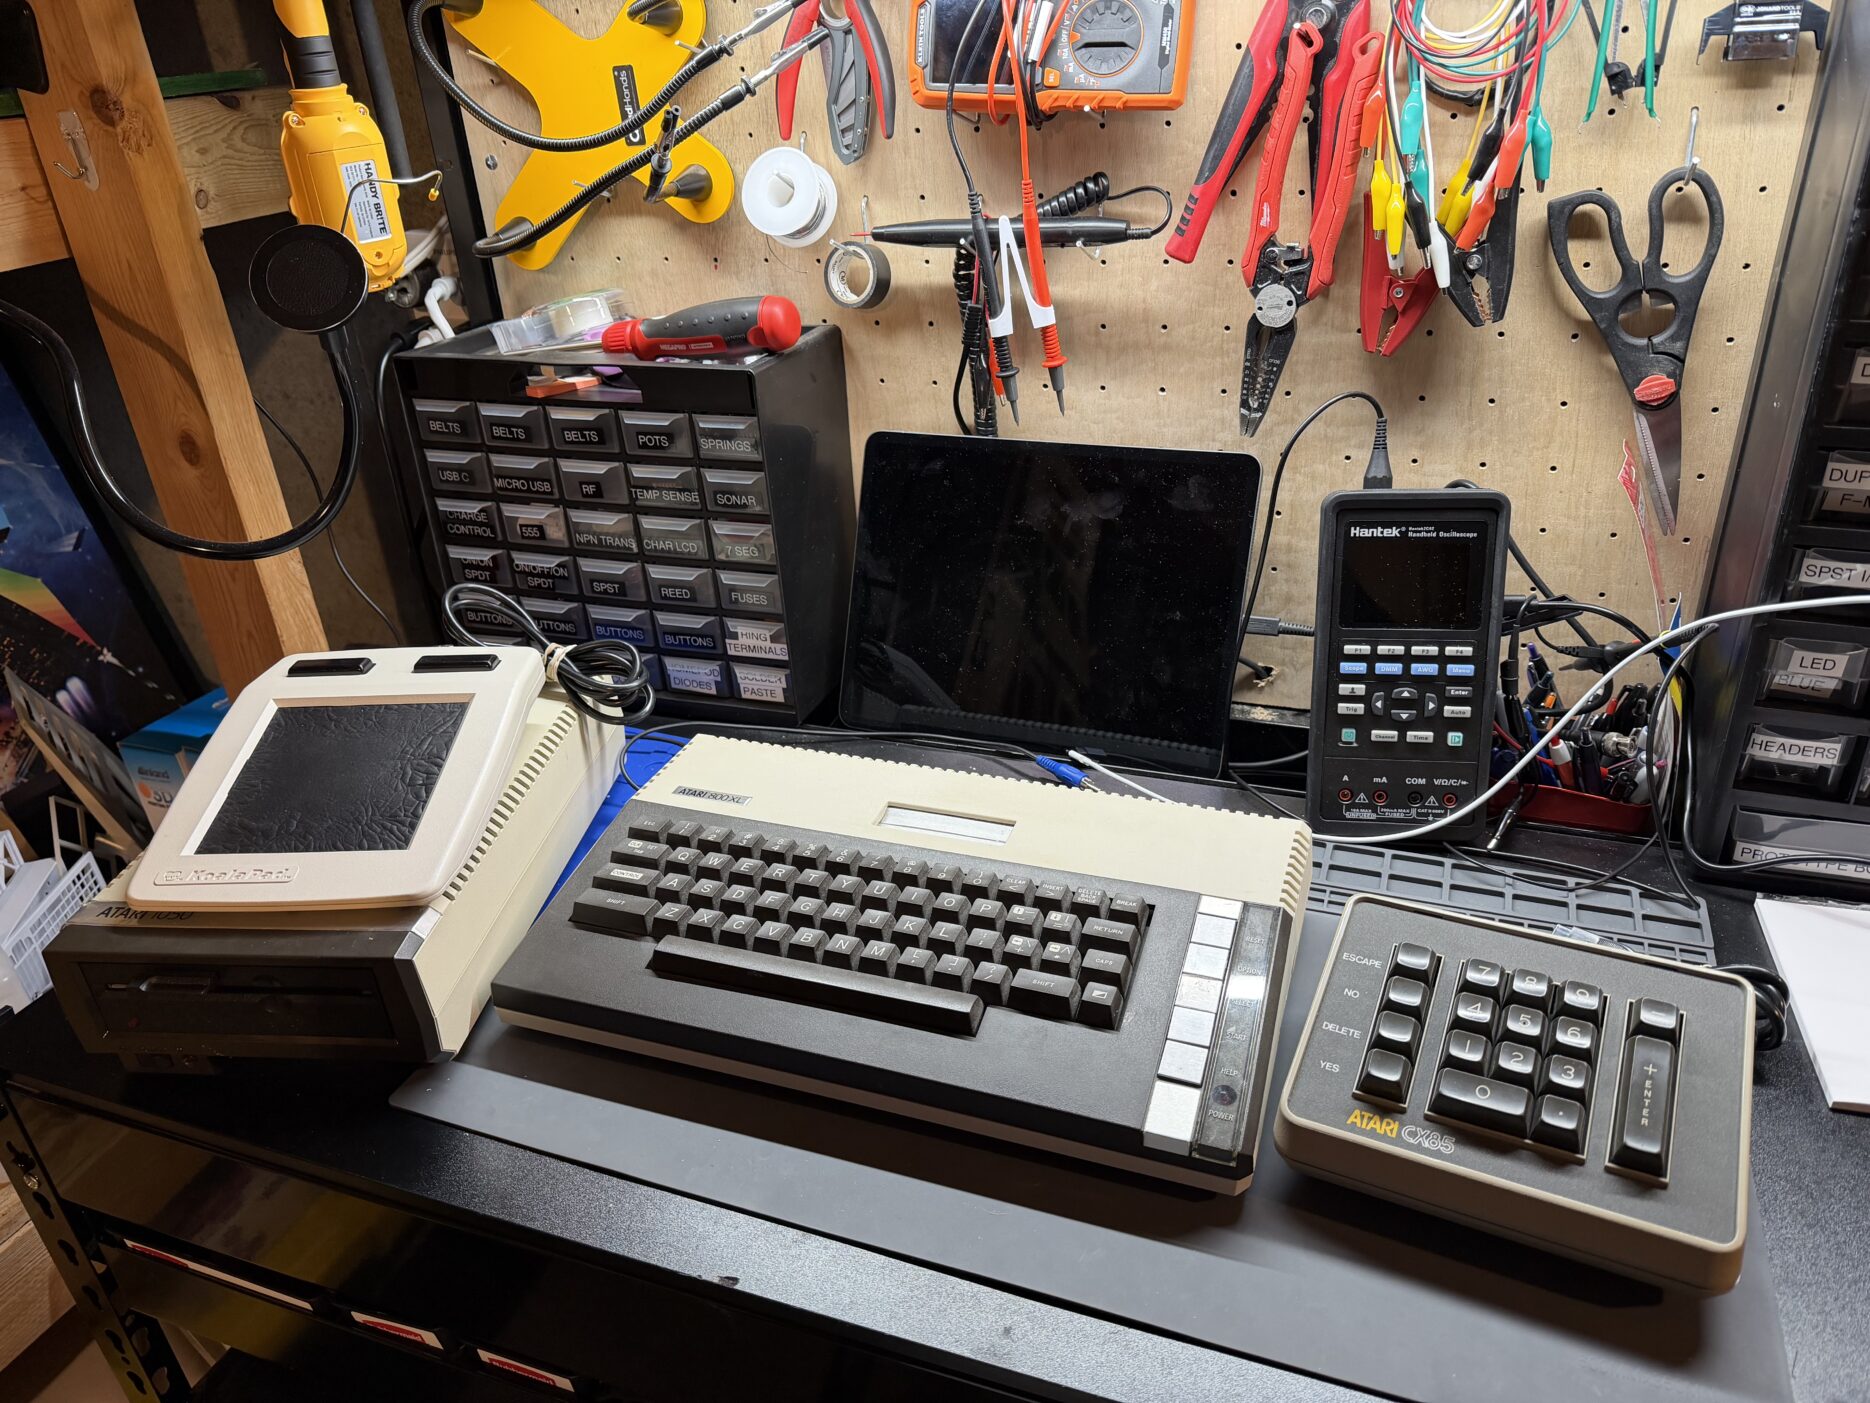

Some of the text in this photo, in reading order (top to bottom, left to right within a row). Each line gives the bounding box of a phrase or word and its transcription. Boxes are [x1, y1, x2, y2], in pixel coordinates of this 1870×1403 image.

[373, 202, 388, 236] BRITE
[429, 420, 462, 434] BELTS
[492, 426, 526, 440] BELTS
[564, 430, 599, 442] BELTS
[638, 434, 669, 447] POTS
[700, 438, 751, 452] SPRINGS
[439, 470, 470, 483] USB C
[494, 477, 551, 493] MICRO USB
[582, 484, 597, 495] RF
[631, 488, 700, 502] TEMP SENSE
[716, 494, 756, 506] SONAR
[447, 509, 489, 523] CHARGE
[447, 523, 495, 538] CONTROL
[522, 525, 540, 537] 555
[1350, 526, 1401, 537] Hantek
[1438, 529, 1478, 539] Oscilloscope
[576, 533, 636, 549] NPN TRANS
[643, 539, 697, 553] CHAR LCD
[725, 545, 759, 557] 7 SEG
[464, 569, 492, 581] SPDT
[1804, 564, 1857, 581] SPST
[527, 576, 554, 589] SPDT
[592, 582, 620, 594] SPST
[661, 587, 691, 599] REED
[731, 592, 768, 605] FUSES
[535, 619, 576, 633] UTTONS
[595, 625, 644, 640] BUTTONS
[664, 634, 714, 647] BUTTONS
[727, 642, 788, 657] TERMINALS
[1799, 656, 1837, 671] LED
[673, 677, 713, 691] DIODES
[1779, 674, 1826, 692] BLUE
[743, 686, 777, 699] PASTE
[1345, 706, 1358, 714] Trig
[1750, 738, 1839, 760] HEADERS
[1342, 774, 1349, 782] A
[1373, 776, 1388, 784] mA
[1405, 777, 1426, 785] COM
[678, 787, 708, 798] ATARI
[677, 851, 690, 861] Q
[708, 856, 724, 866] W
[740, 862, 754, 872] E
[772, 868, 786, 878] R
[666, 878, 679, 888] A
[808, 873, 820, 883] T
[841, 879, 852, 889] Y
[700, 884, 713, 893] S
[732, 889, 745, 899] D
[873, 885, 887, 895] U
[765, 896, 779, 904] F
[943, 898, 956, 907] O
[1116, 899, 1137, 907] BREAK
[664, 907, 680, 917] Z
[800, 902, 812, 911] G
[979, 903, 992, 913] P
[95, 906, 148, 920] ATARI
[698, 913, 713, 924] X
[832, 909, 846, 918] H
[732, 920, 745, 930] C
[869, 914, 881, 925] J
[903, 920, 917, 931] K
[768, 926, 781, 936] V
[939, 927, 950, 938] L
[1093, 925, 1124, 935] RETURN
[800, 932, 813, 943] B
[835, 939, 850, 950] N
[870, 946, 886, 956] M
[1095, 957, 1113, 966] CAPS
[1342, 952, 1383, 969] ESCAPE
[1478, 965, 1492, 977] 7
[1032, 979, 1055, 988] SHIFT
[1525, 975, 1538, 988] 8
[1343, 987, 1360, 999] NO
[1576, 988, 1590, 1001] 9
[1466, 1002, 1482, 1015] 4
[1519, 1014, 1532, 1028] 5
[1322, 1020, 1362, 1039] DELETE
[1567, 1026, 1581, 1040] 6
[1226, 1031, 1247, 1041] START
[1511, 1052, 1524, 1066] 2
[1220, 1067, 1239, 1076] HELP
[1319, 1060, 1341, 1073] YES
[1561, 1065, 1575, 1080] 3
[1641, 1080, 1653, 1126] ENTER
[1208, 1109, 1234, 1121] POWER
[1346, 1108, 1456, 1154] ATARI CX85
